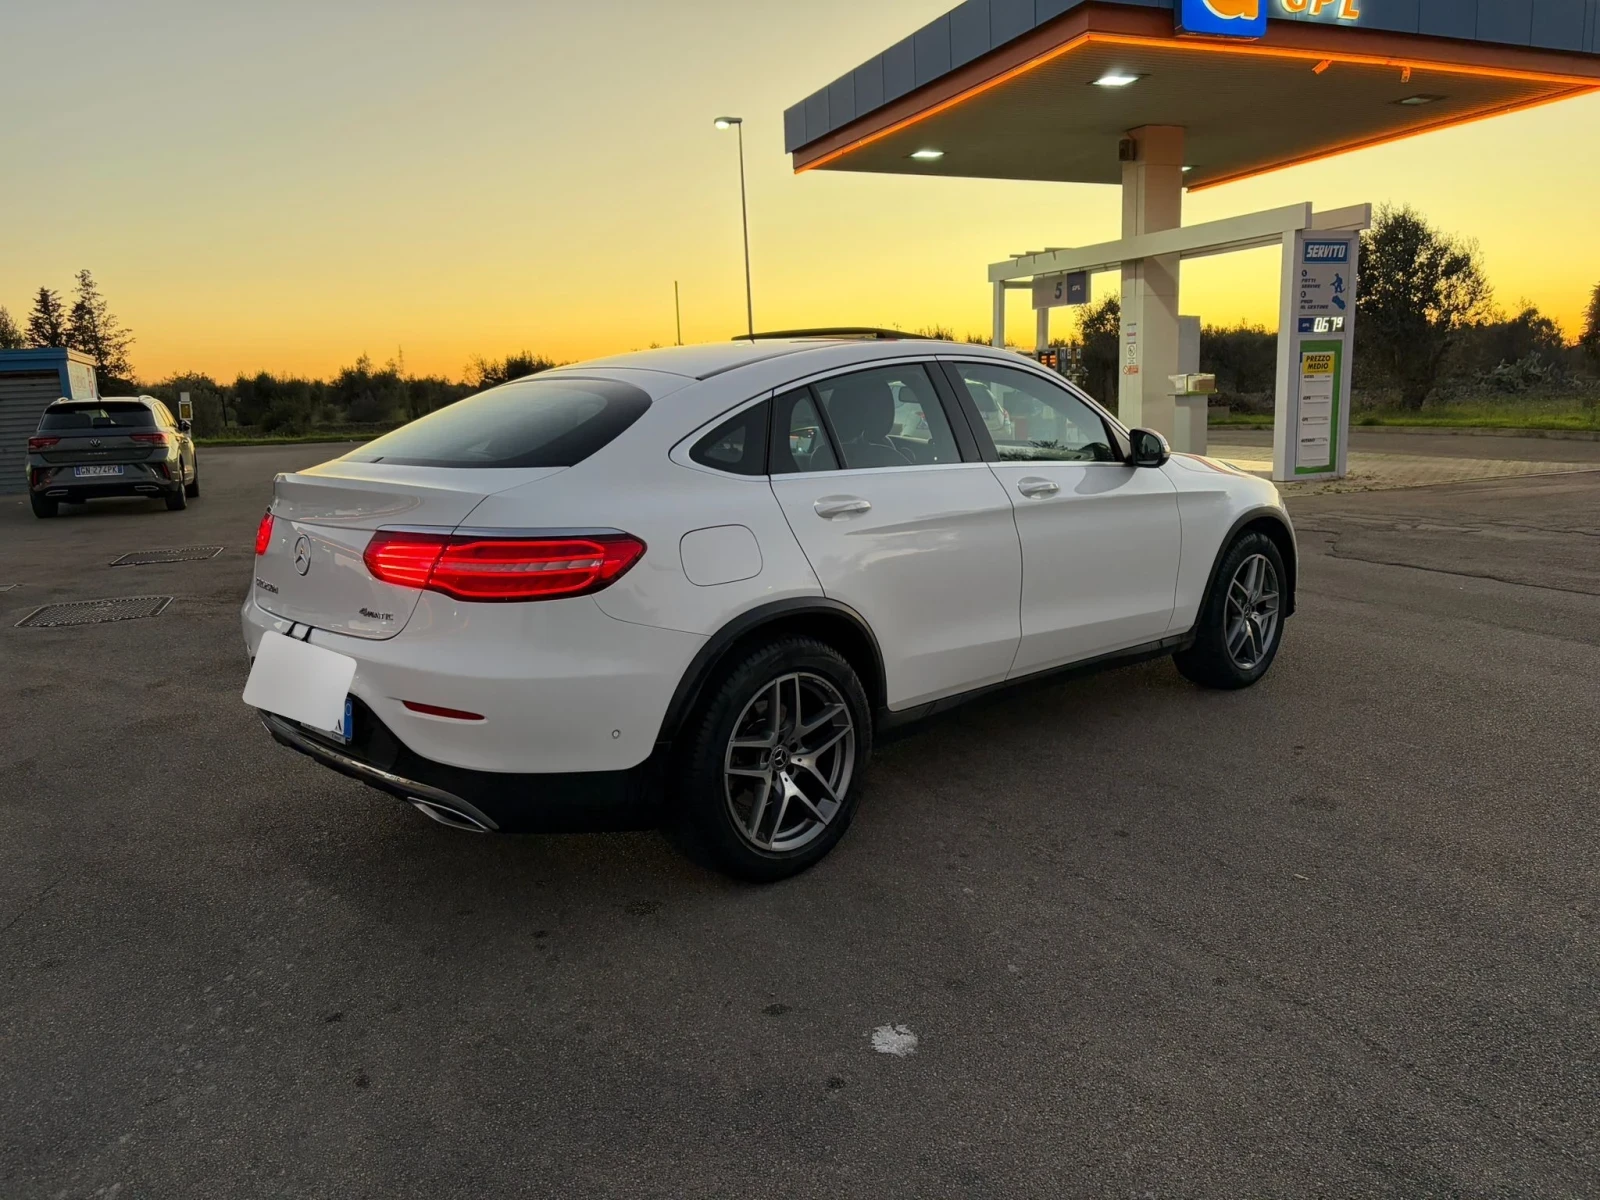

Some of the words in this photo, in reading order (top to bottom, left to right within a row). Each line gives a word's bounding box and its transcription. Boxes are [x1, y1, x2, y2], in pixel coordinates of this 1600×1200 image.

[1306, 244, 1346, 258] SERVITO
[1054, 281, 1063, 299] 5
[1307, 362, 1329, 370] MEDIO
